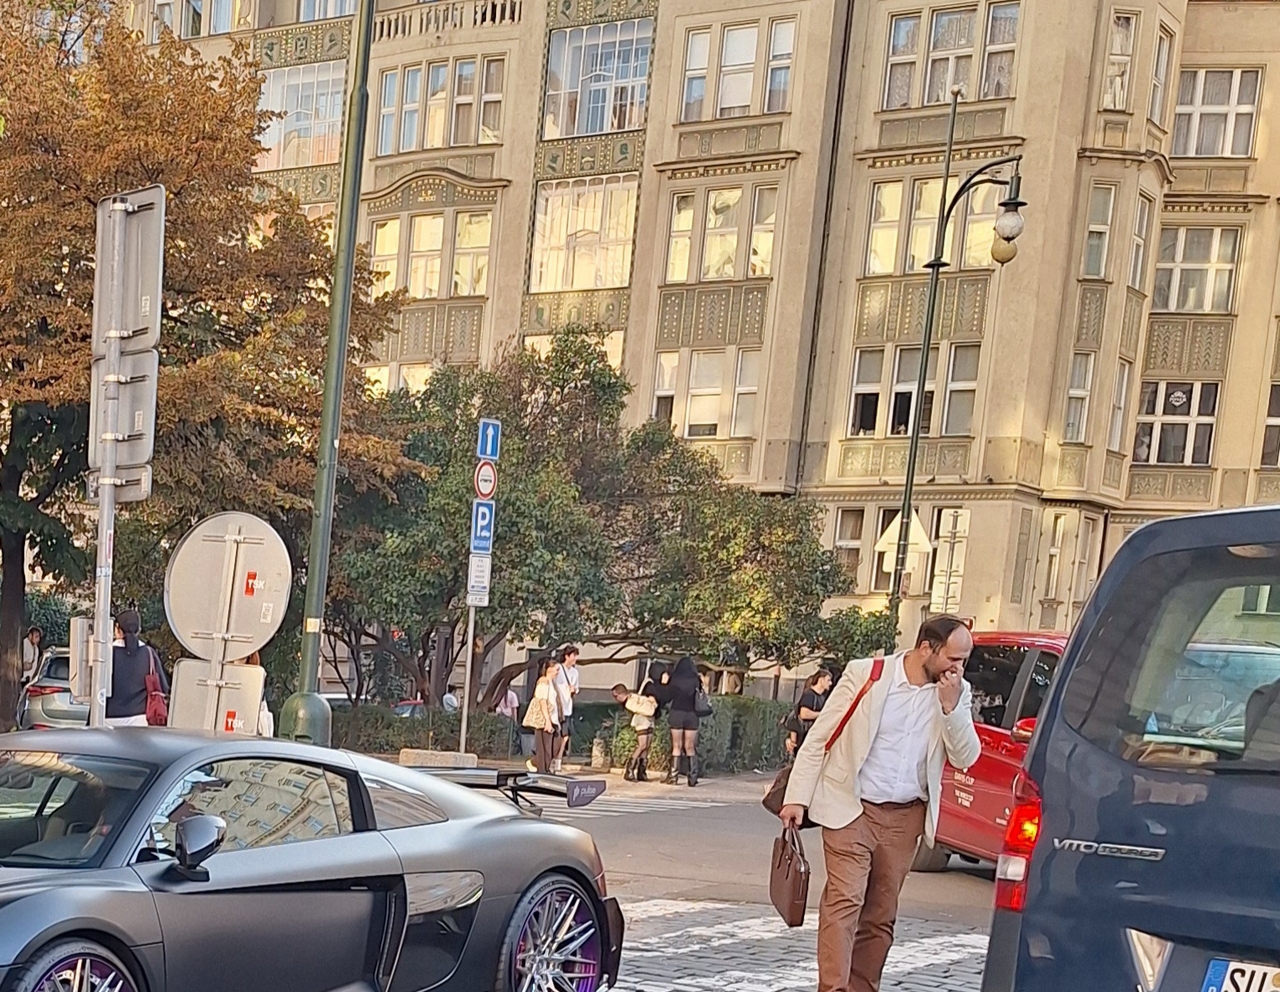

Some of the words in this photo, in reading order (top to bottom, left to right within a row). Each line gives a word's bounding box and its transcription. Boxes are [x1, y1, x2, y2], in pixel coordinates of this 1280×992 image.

[476, 506, 490, 536] P
[248, 579, 265, 590] TSK
[227, 718, 244, 729] TSK
[1053, 837, 1099, 855] VITO
[1101, 845, 1159, 859] TOURER
